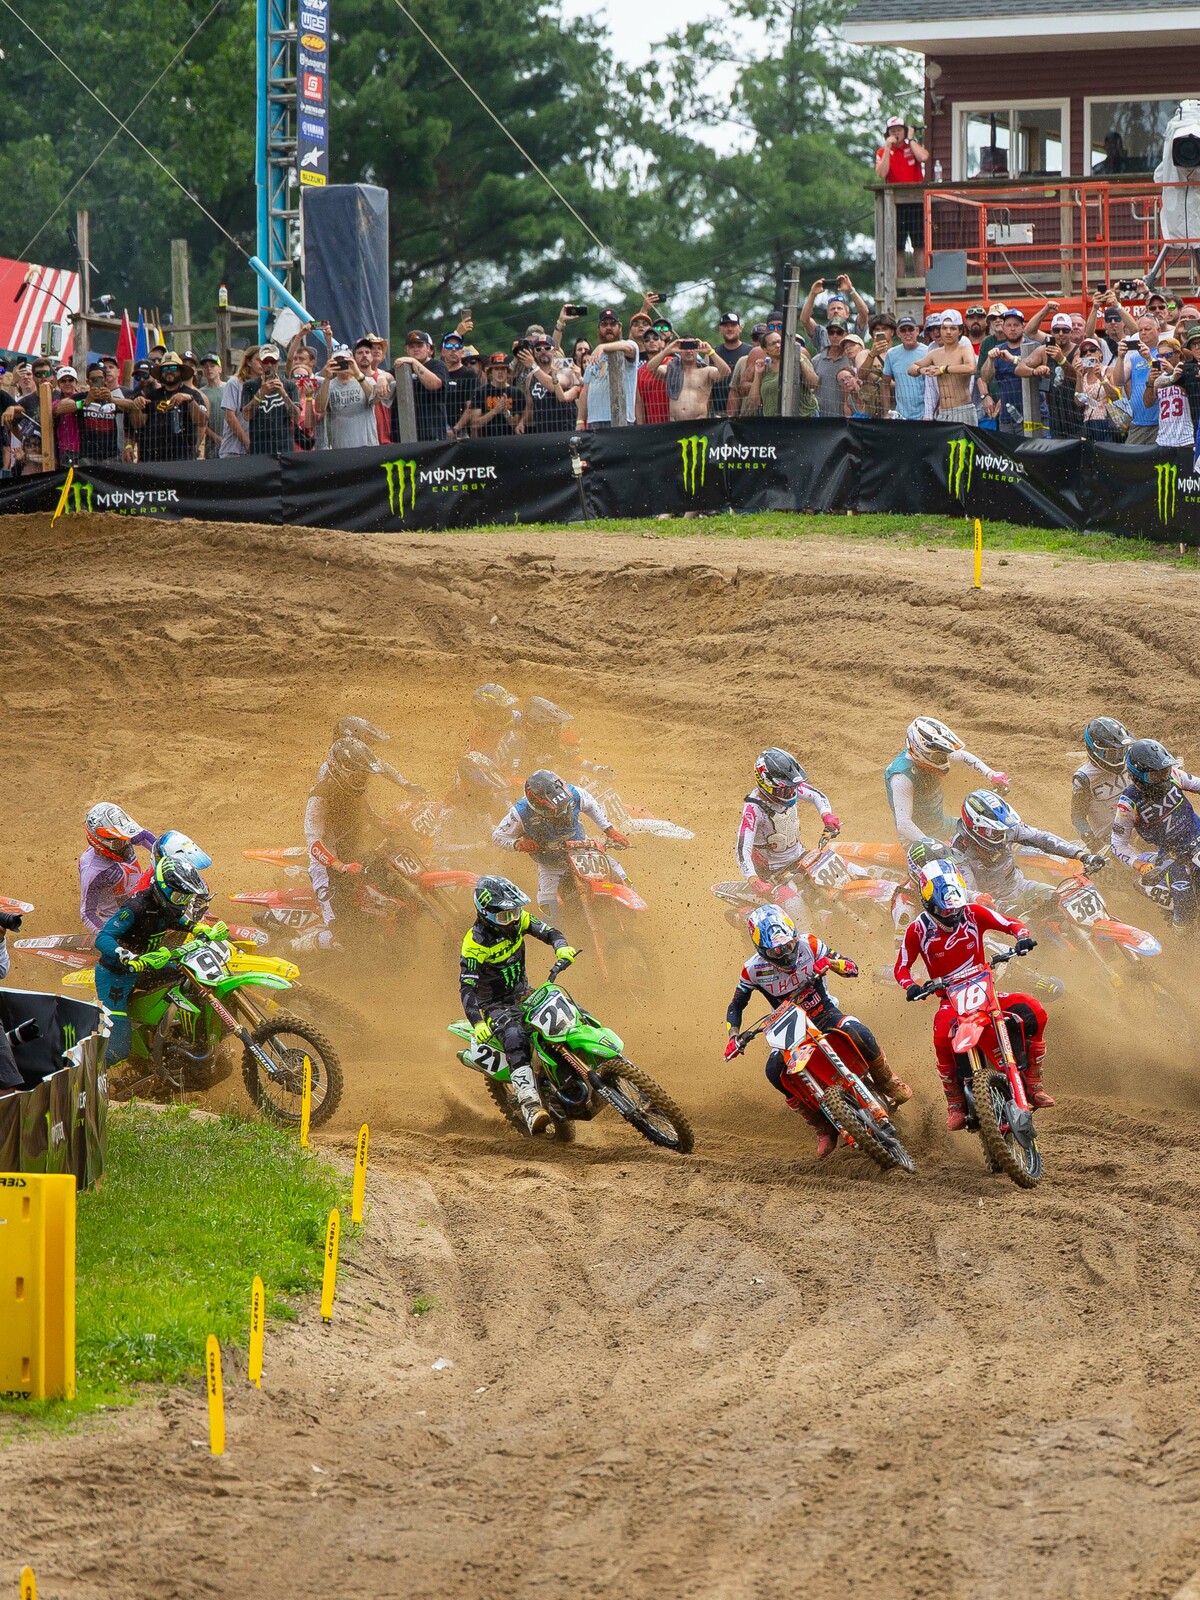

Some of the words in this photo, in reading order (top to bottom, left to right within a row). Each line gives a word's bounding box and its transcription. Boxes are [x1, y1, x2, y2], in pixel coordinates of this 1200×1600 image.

[301, 12, 327, 33] WPS
[307, 123, 324, 135] YAMAHA
[303, 174, 323, 185] SUZUKI
[83, 410, 116, 420] HONDA
[1160, 397, 1184, 420] 23
[709, 443, 777, 461] MONSTER
[419, 465, 498, 485] MONSTER
[718, 462, 768, 470] ENERGY
[431, 482, 487, 493] ENERGY
[982, 472, 1022, 483] ENERGY
[96, 488, 180, 508] MONSTER
[552, 791, 568, 806] FLY
[1140, 785, 1183, 824] FXR
[577, 857, 610, 877] 309
[818, 855, 845, 888] 841
[1149, 885, 1172, 908] 93
[279, 910, 312, 930] 787
[36, 949, 65, 960] DUNLOP
[764, 965, 813, 995] THOR
[802, 992, 822, 1011] Bull
[955, 981, 988, 1016] 18
[211, 999, 235, 1029] SHOWA
[539, 994, 576, 1036] 21
[773, 1009, 799, 1051] 7
[248, 1044, 277, 1074] DUNLOP
[473, 1044, 503, 1074] 21
